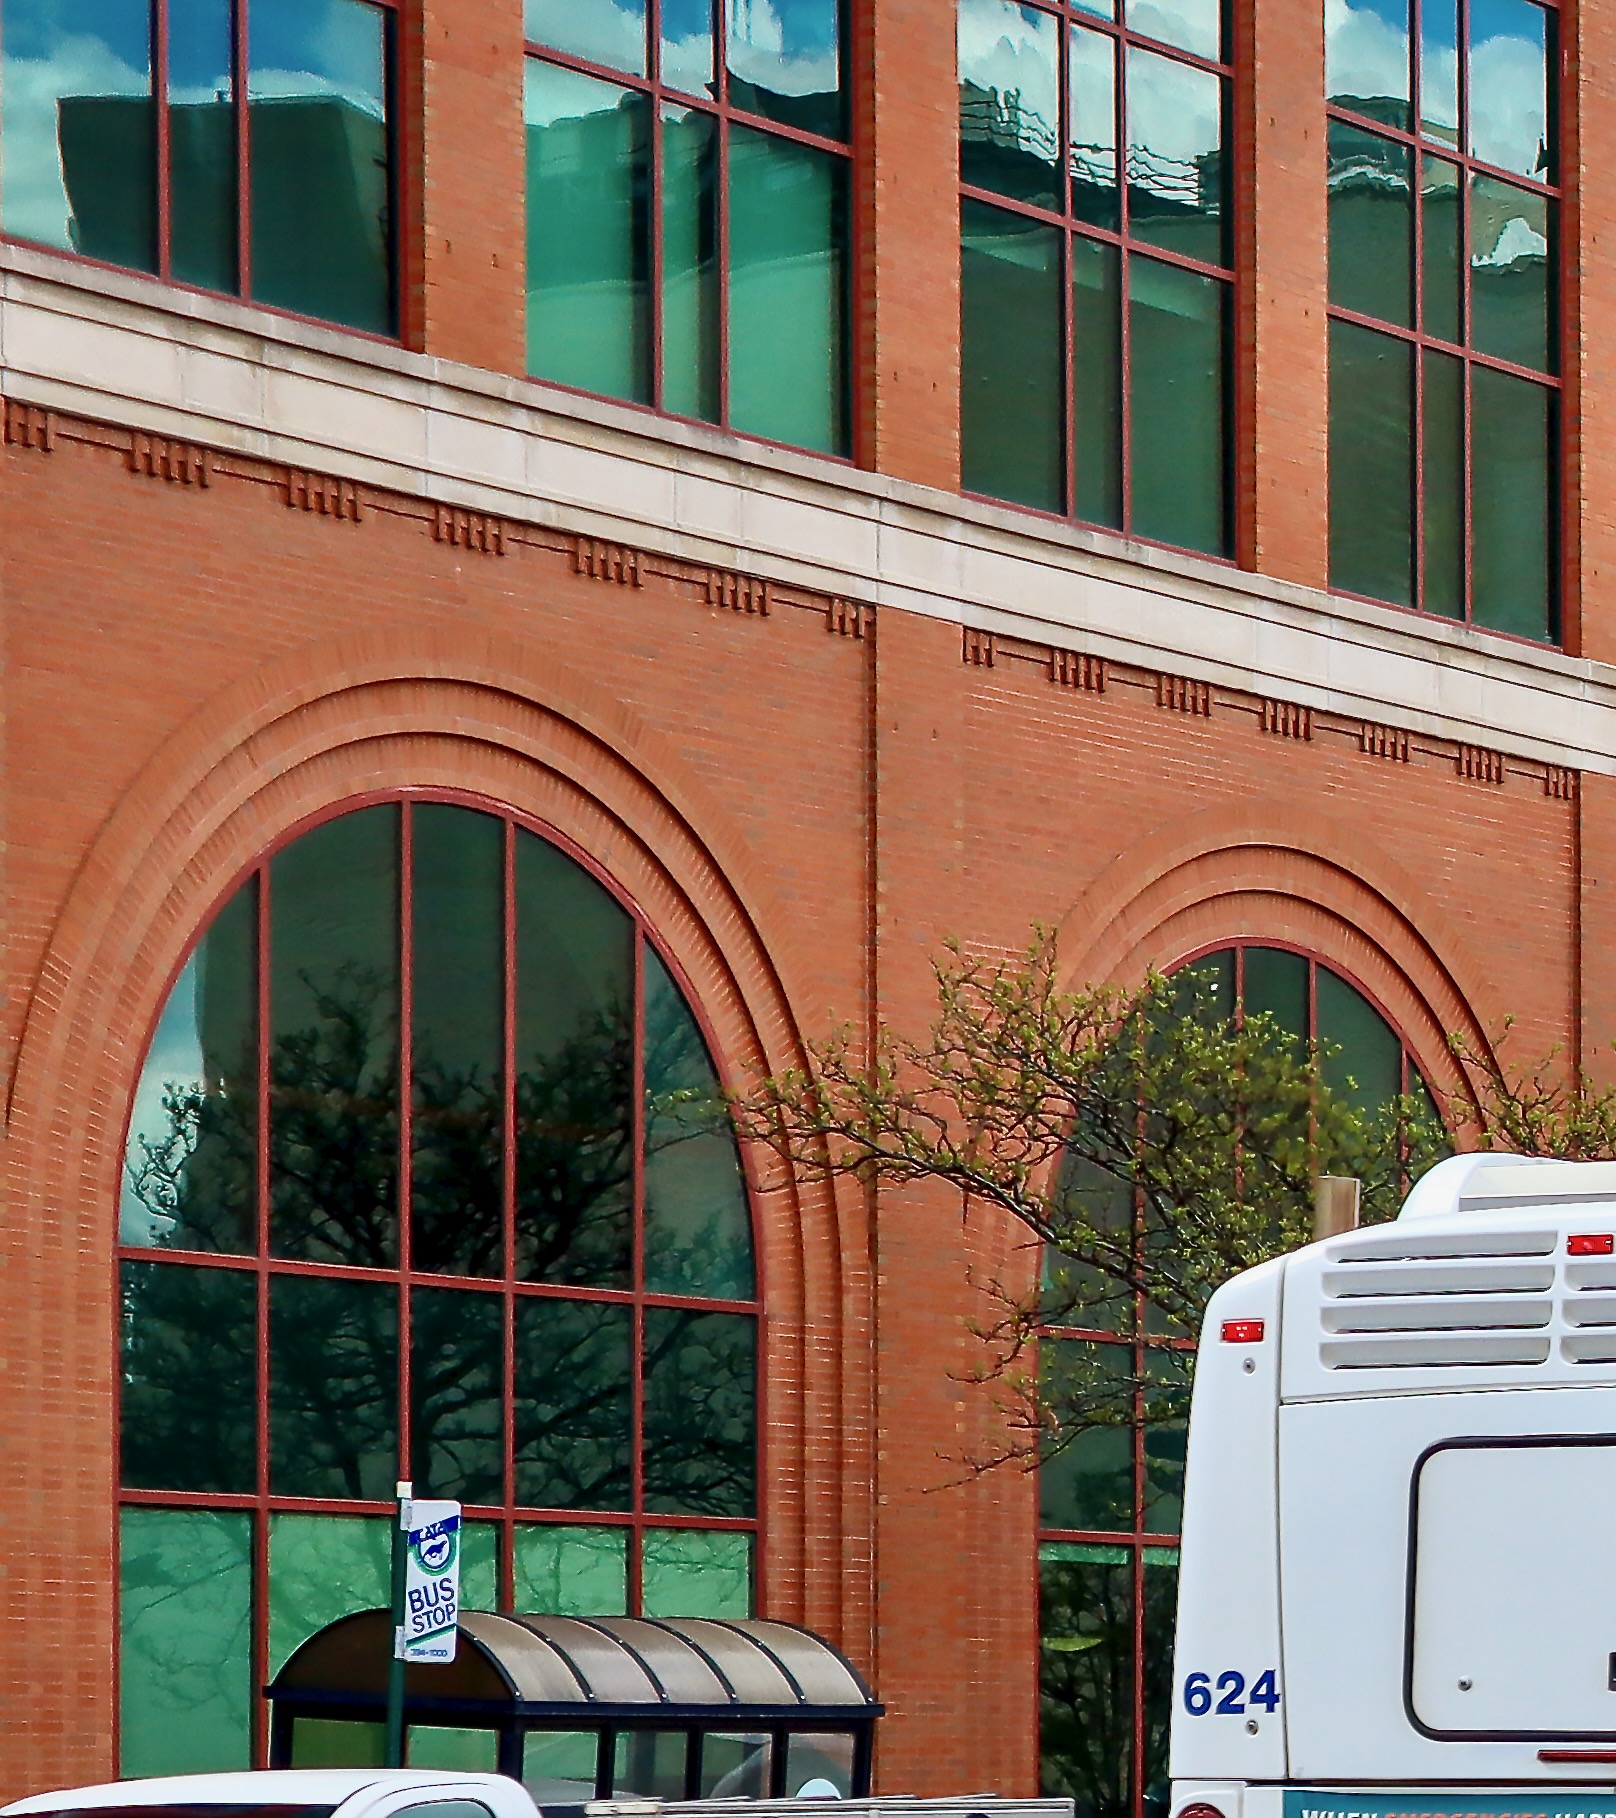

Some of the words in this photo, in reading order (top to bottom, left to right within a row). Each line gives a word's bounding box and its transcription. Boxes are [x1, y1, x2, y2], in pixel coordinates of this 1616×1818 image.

[408, 1577, 455, 1614] BUS
[412, 1603, 456, 1634] STOP
[1184, 1669, 1280, 1717] 624
